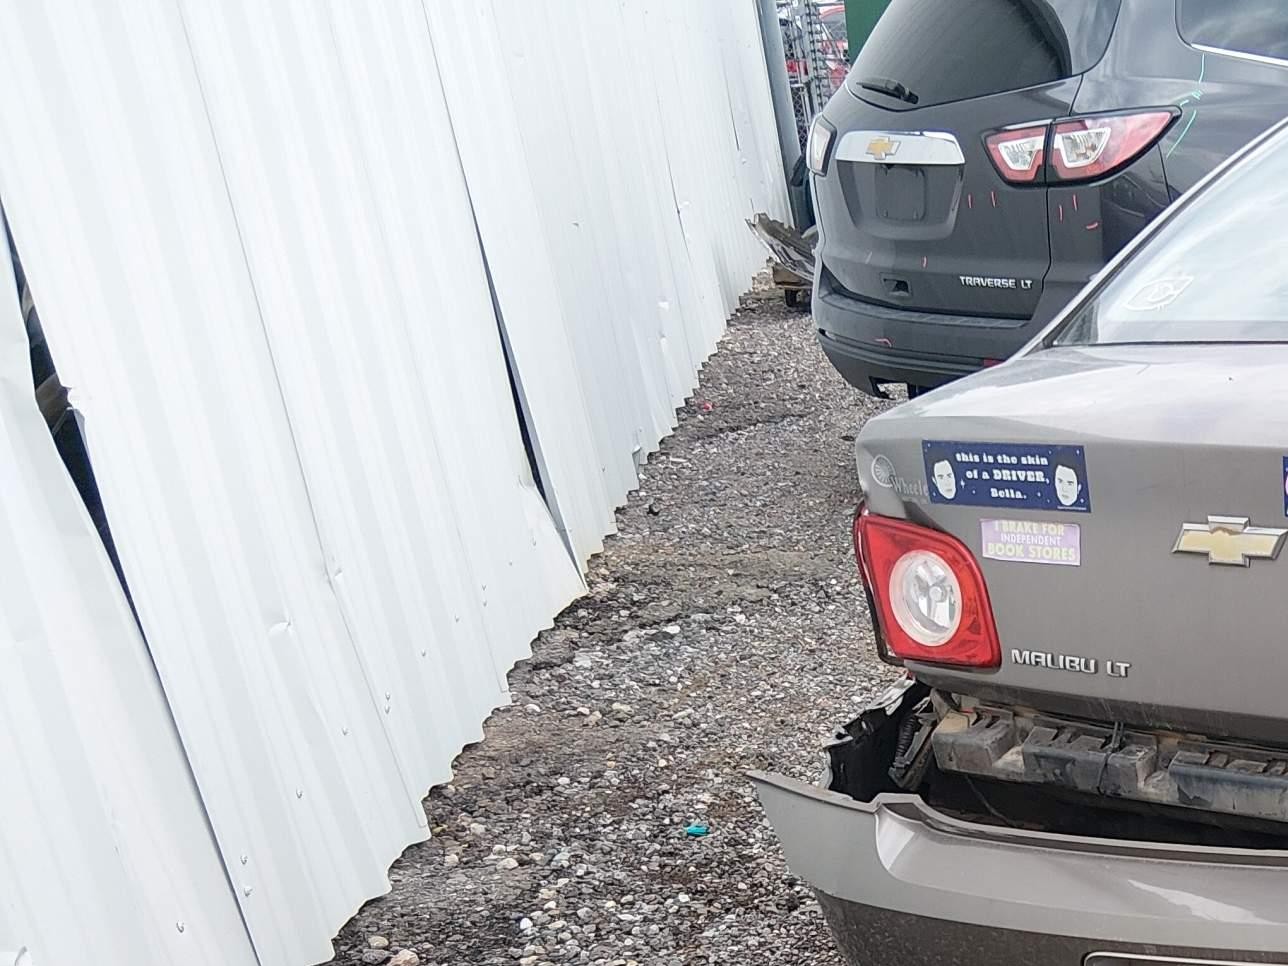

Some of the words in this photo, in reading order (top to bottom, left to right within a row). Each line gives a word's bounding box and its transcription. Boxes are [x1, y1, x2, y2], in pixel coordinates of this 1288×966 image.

[959, 275, 1017, 289] TRAVERSE
[1020, 279, 1033, 289] LT
[955, 452, 980, 463] this
[982, 453, 994, 463] is
[997, 454, 1017, 464] the
[1021, 455, 1048, 465] skin
[966, 469, 978, 479] of
[982, 471, 990, 480] a
[992, 469, 1050, 484] DRIVER,
[990, 488, 1027, 499] Bella.
[1001, 520, 1038, 534] BRAKE
[1040, 522, 1065, 536] FOR
[1000, 533, 1063, 546] INDEPENDENT
[987, 542, 1025, 557] BOOK
[1029, 545, 1076, 561] STORES
[1011, 648, 1097, 674] MALIBU
[1106, 660, 1131, 678] LT
